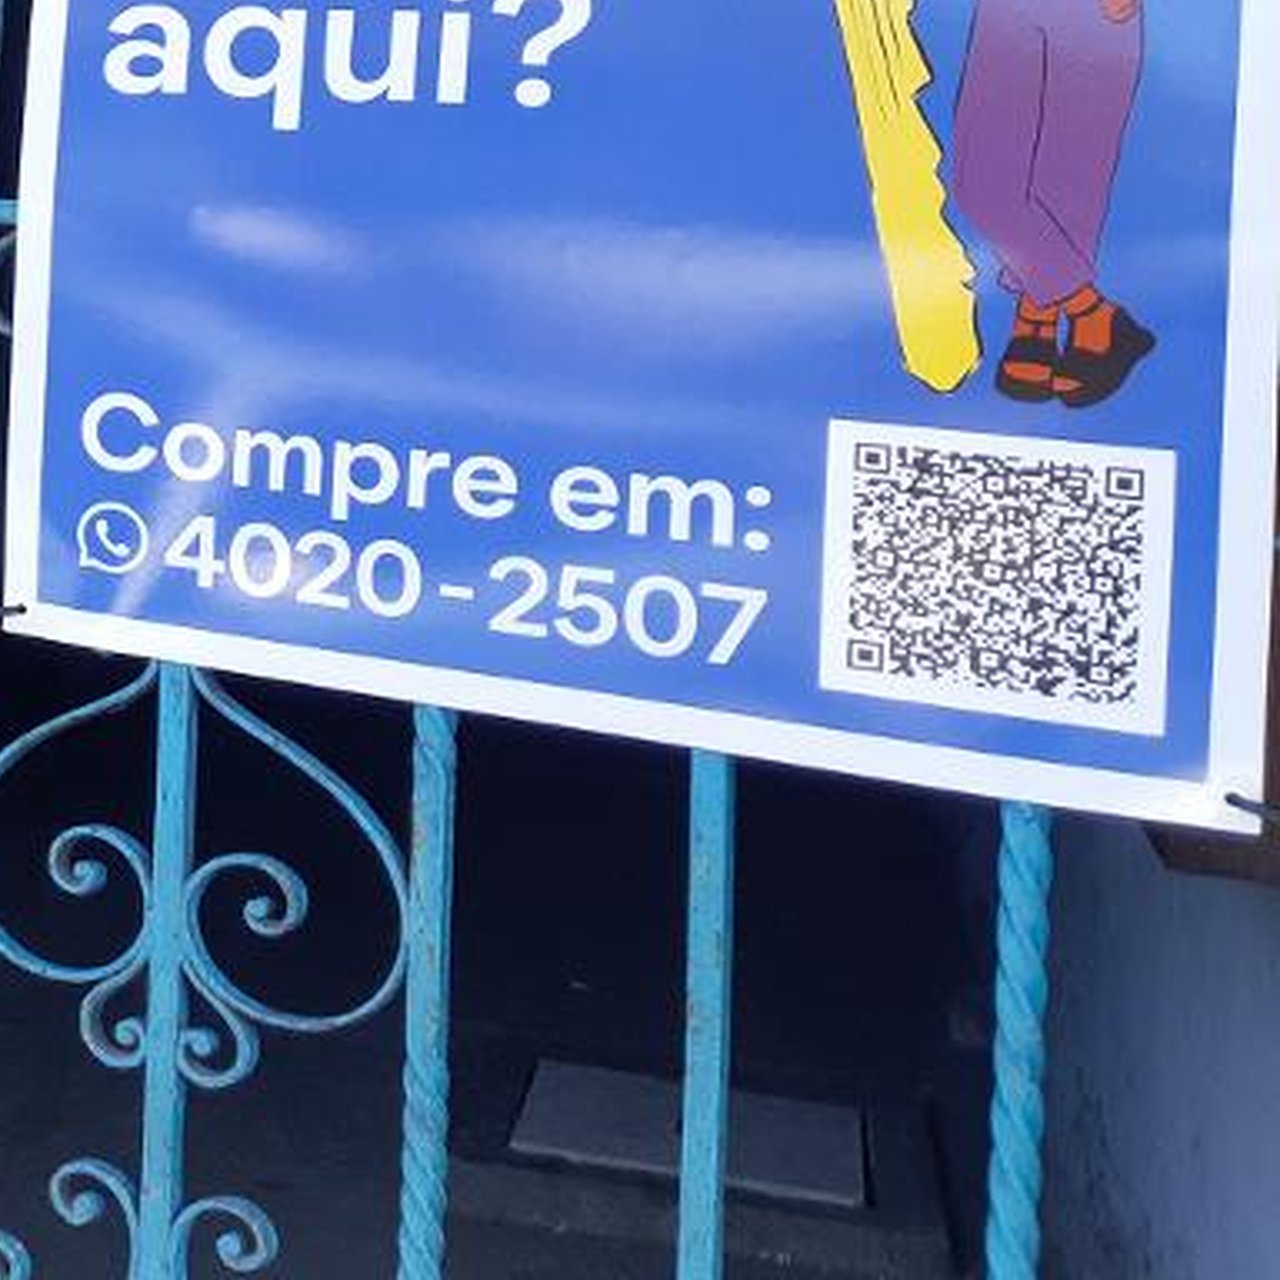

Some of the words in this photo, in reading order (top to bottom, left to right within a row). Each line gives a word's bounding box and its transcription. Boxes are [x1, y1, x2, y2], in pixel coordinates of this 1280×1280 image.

[81, 391, 518, 521] Compre
[549, 465, 772, 552] em:
[162, 512, 768, 665] 4020-2507
